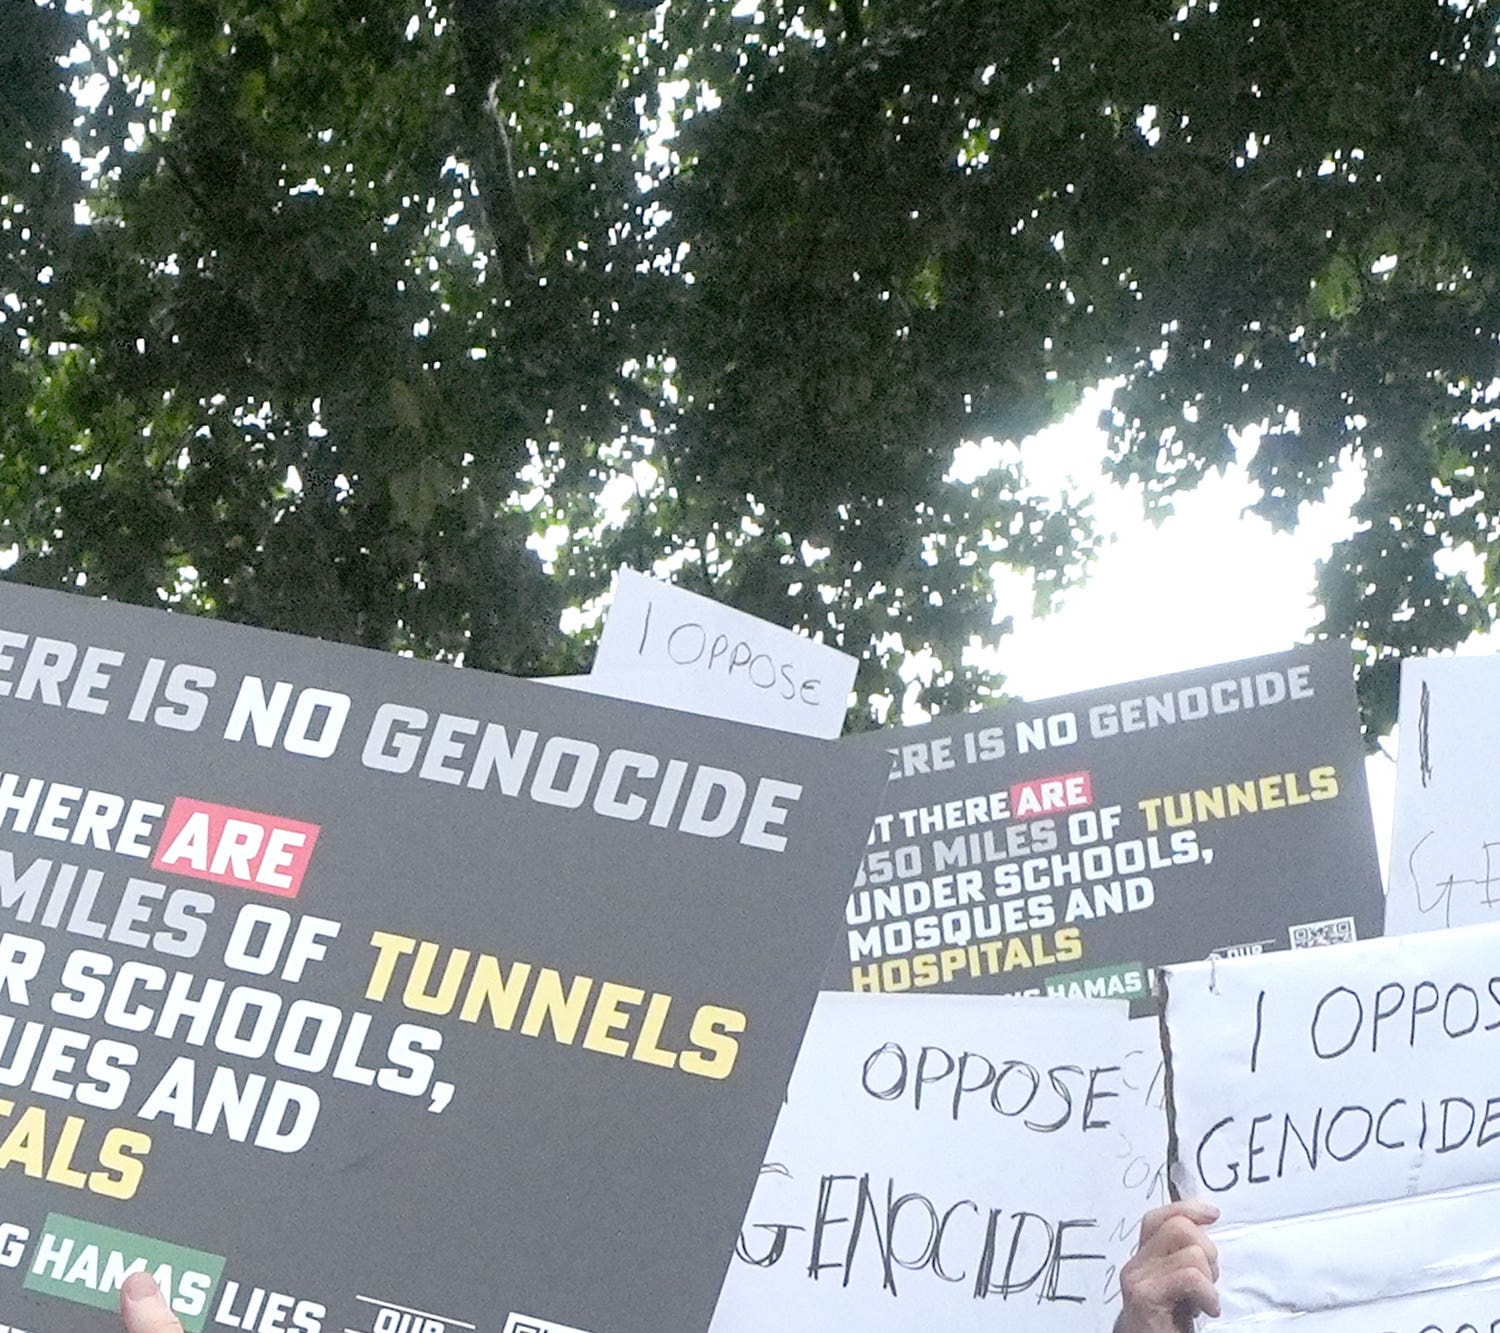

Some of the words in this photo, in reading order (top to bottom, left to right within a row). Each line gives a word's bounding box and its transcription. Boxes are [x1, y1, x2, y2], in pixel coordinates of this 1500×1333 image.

[638, 602, 653, 656] I
[667, 622, 823, 707] OPPOSE
[129, 661, 218, 731] IS
[226, 678, 351, 757] NO
[365, 705, 804, 852] GENOCIDE
[964, 727, 1005, 763] IS
[1017, 712, 1078, 755] NO
[1088, 665, 1315, 739] GENOCIDE
[1421, 679, 1432, 788] I
[165, 814, 307, 888] ARE
[899, 791, 1010, 837] THERE
[1015, 776, 1090, 816] ARE
[933, 819, 1058, 871] MILES
[1069, 805, 1121, 846] OF
[1139, 765, 1339, 830] TUNNELS
[845, 860, 984, 925] UNDER
[994, 830, 1214, 897] SCHOOLS,
[849, 900, 1051, 962] MOSQUES
[1067, 877, 1155, 925] AND
[223, 906, 341, 982] OF
[364, 931, 750, 1080] TUNNELS
[852, 928, 1082, 993] HOSPITALS
[49, 951, 458, 1114] SCHOOLS,
[1250, 990, 1264, 1073] I
[138, 1073, 321, 1156] AND
[861, 1043, 1120, 1134] OPPOSE
